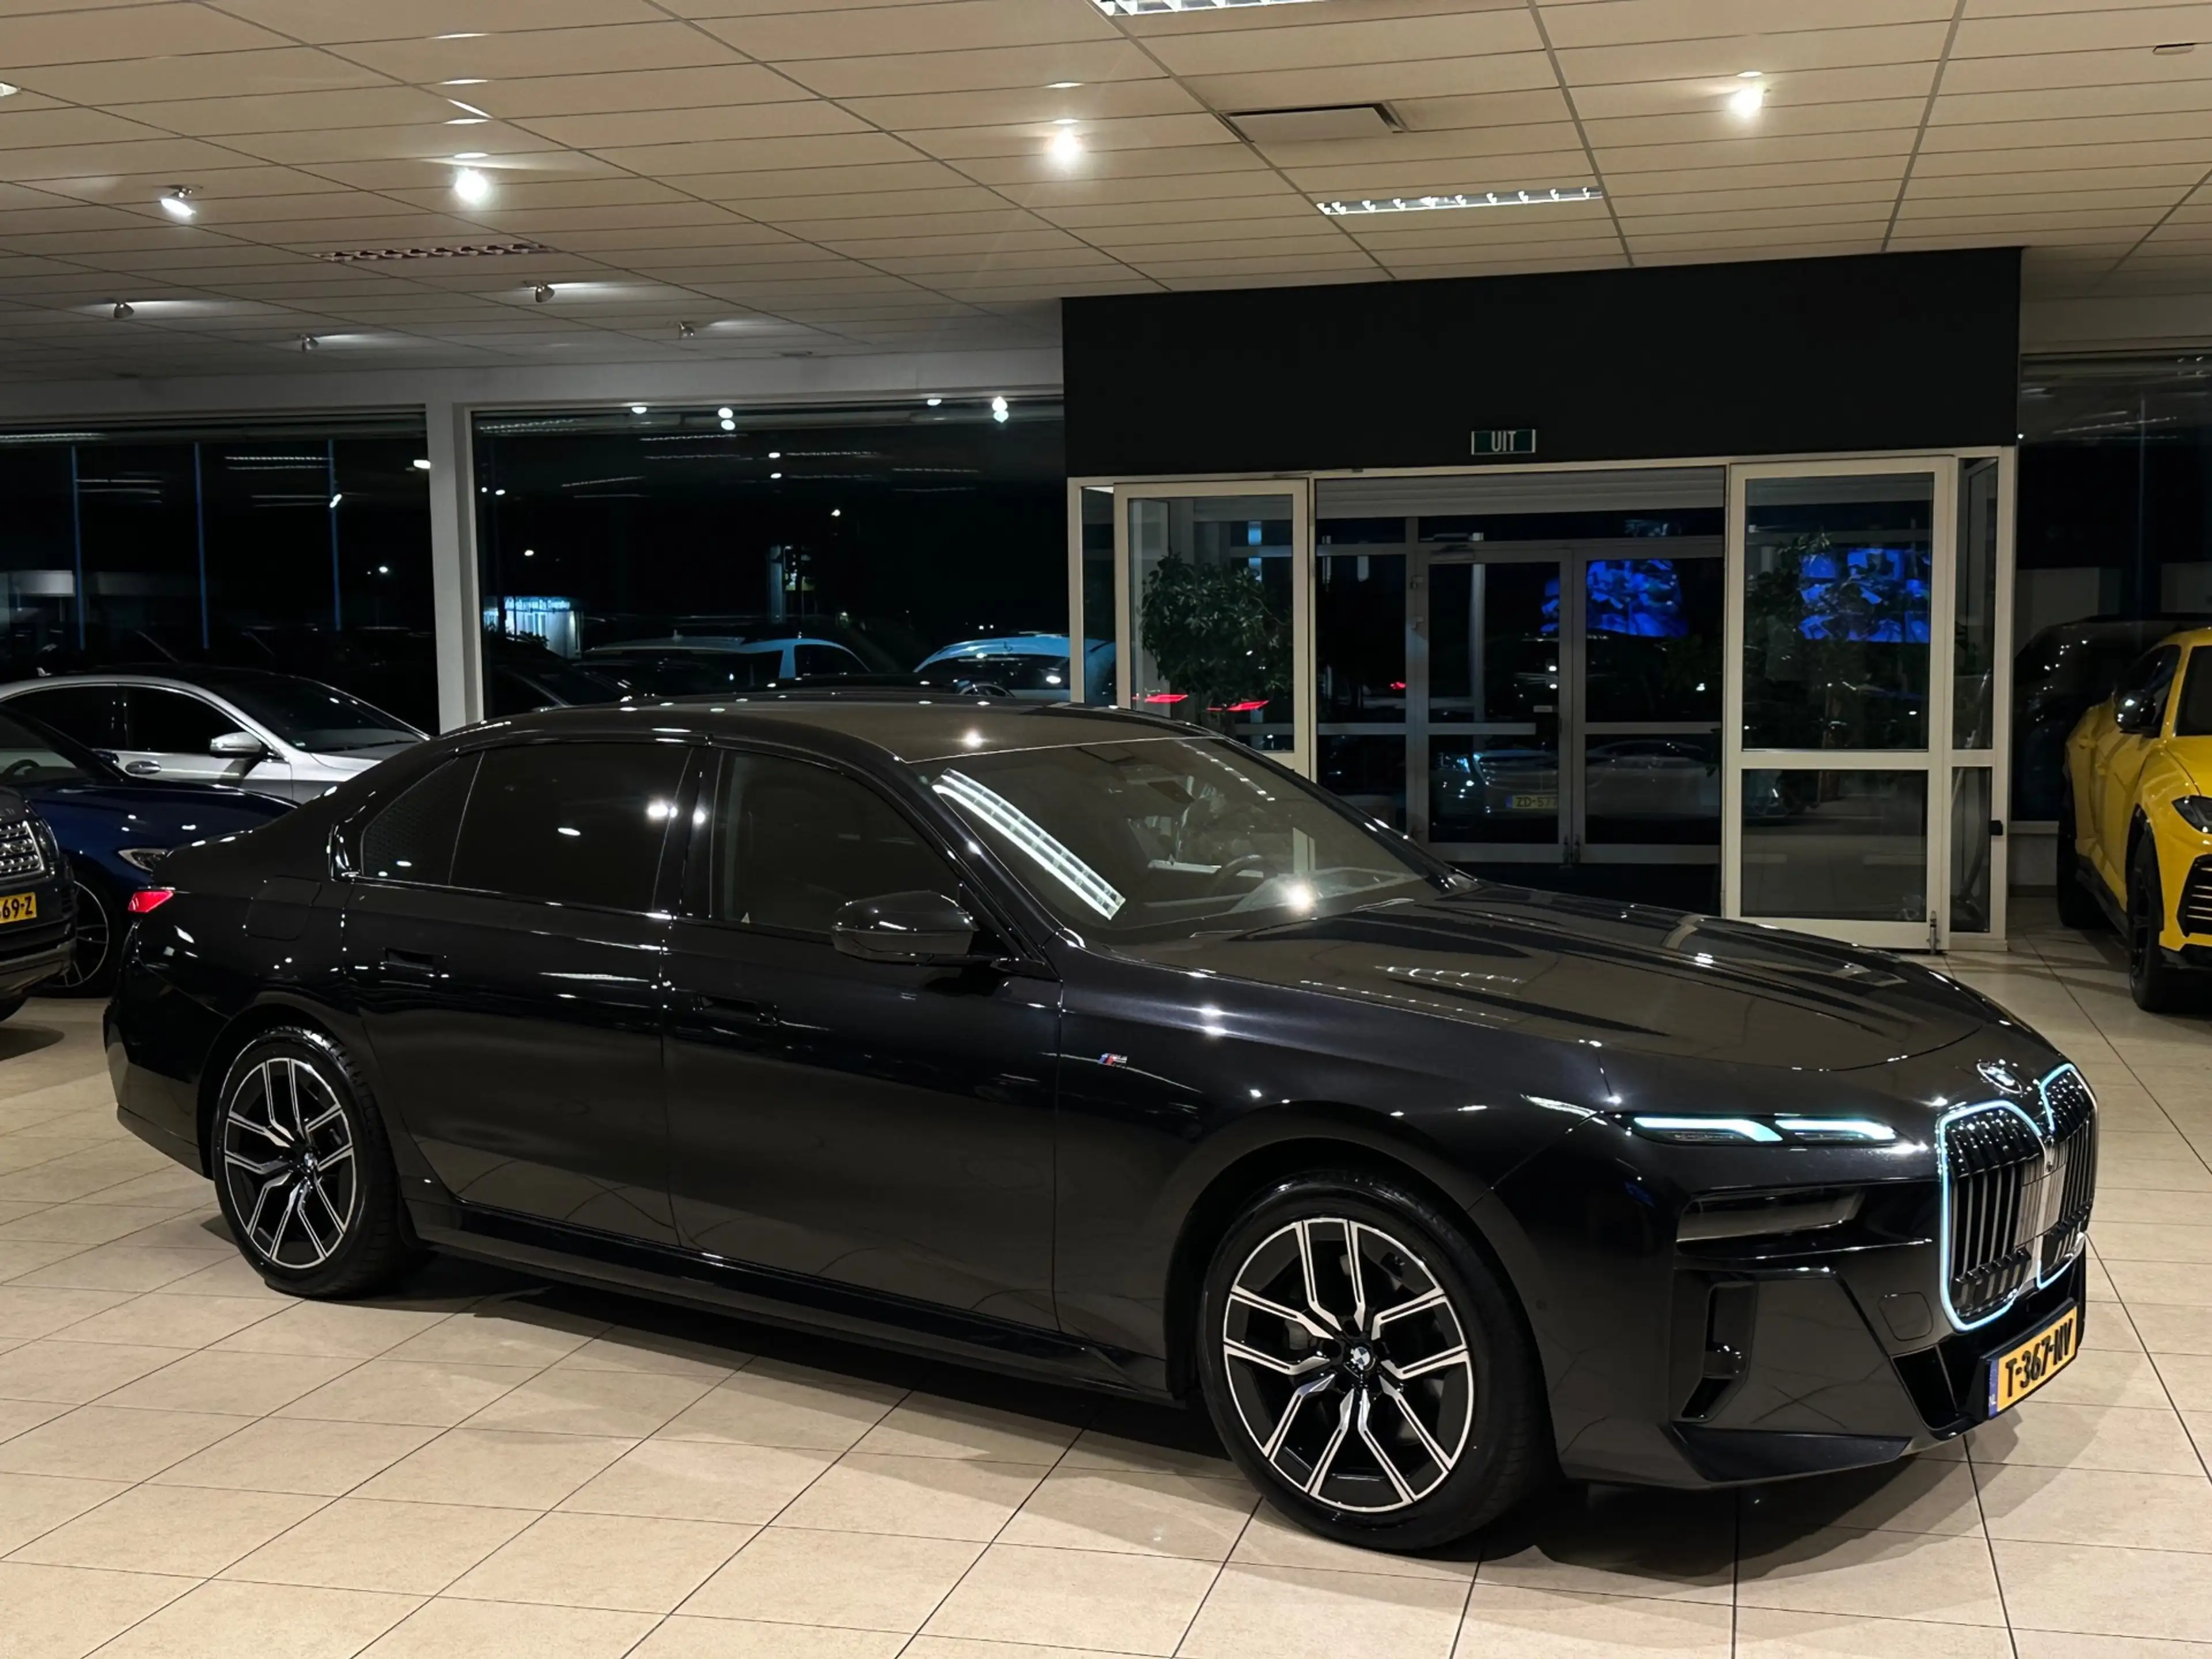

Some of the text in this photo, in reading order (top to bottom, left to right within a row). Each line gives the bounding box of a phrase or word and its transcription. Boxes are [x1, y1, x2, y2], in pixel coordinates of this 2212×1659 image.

[1491, 431, 1516, 452] UIT
[0, 896, 33, 919] 69-Z
[2005, 1317, 2073, 1397] T-367-NV
